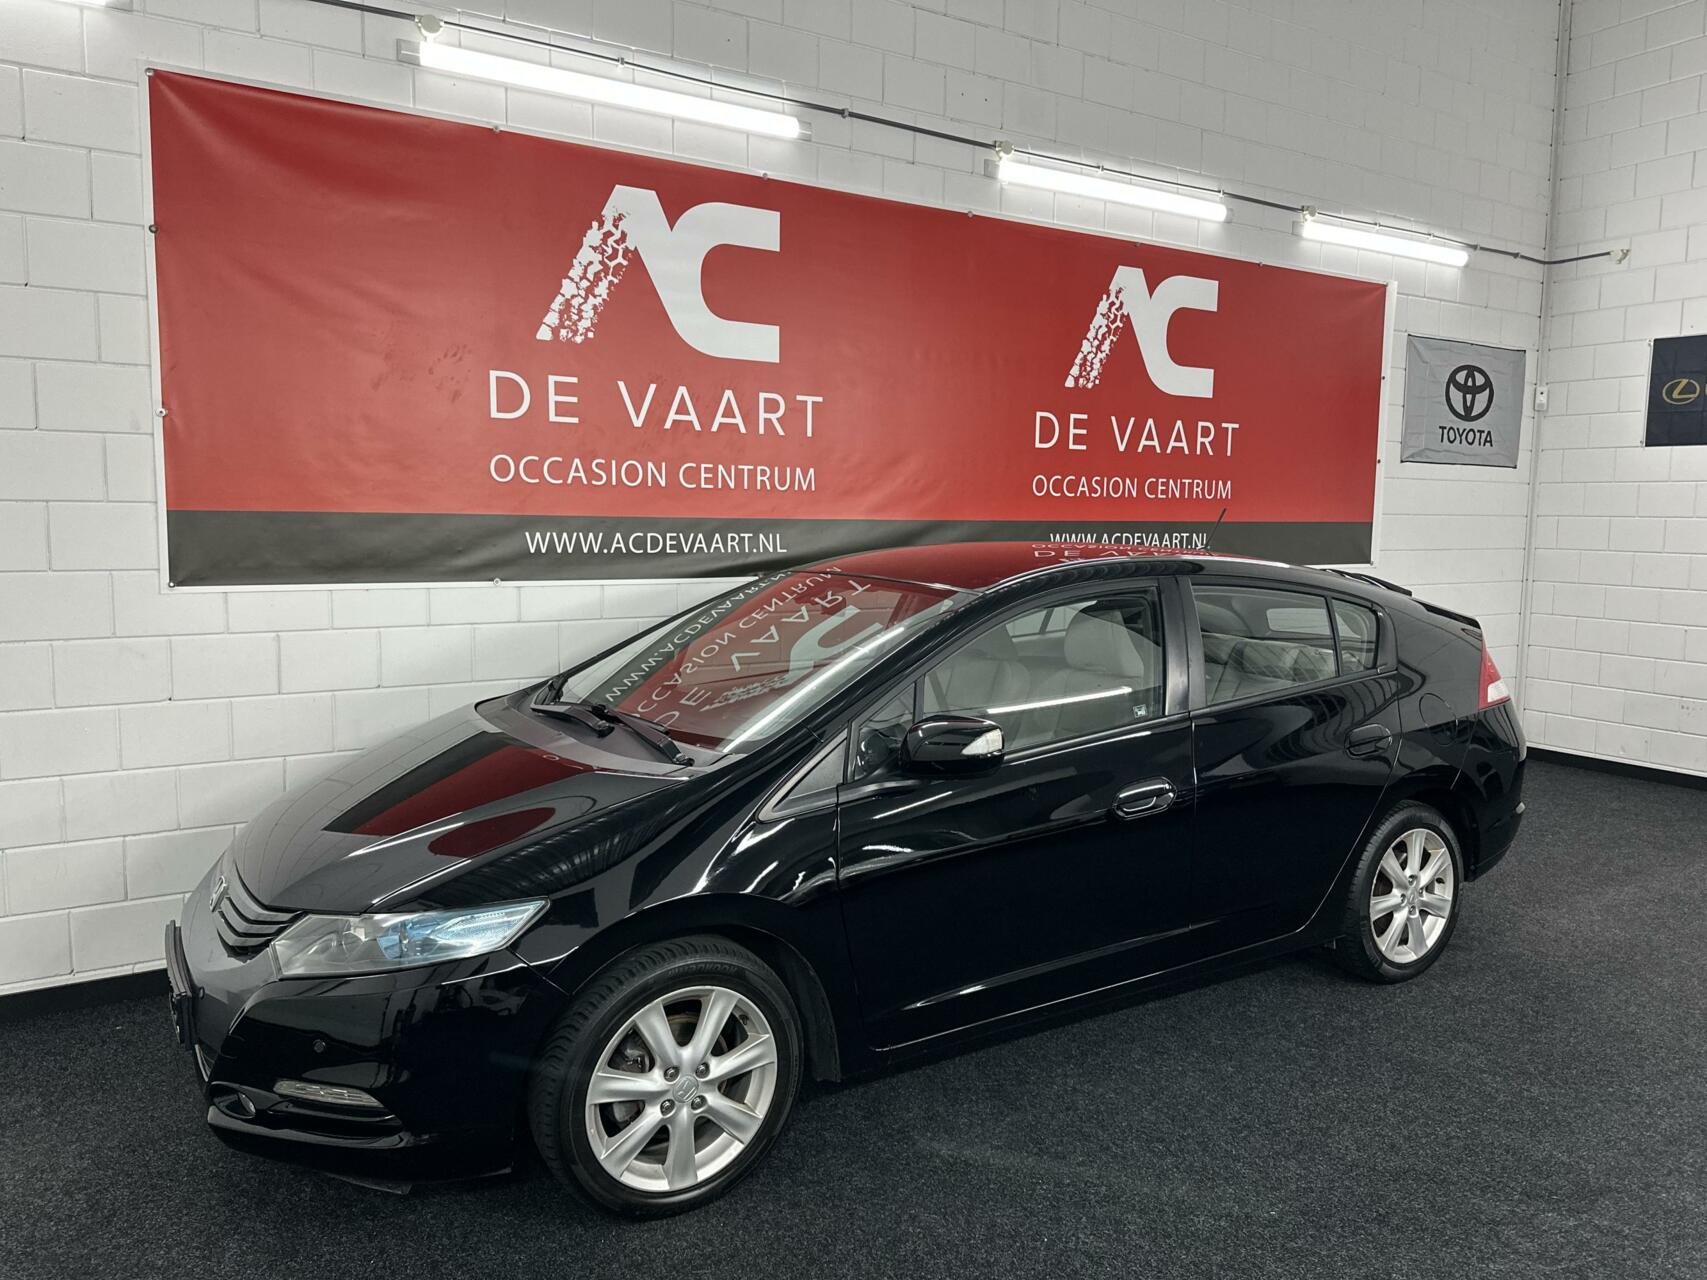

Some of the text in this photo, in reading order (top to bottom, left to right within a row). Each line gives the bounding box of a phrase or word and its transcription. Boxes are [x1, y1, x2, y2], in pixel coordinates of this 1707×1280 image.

[536, 184, 781, 364] AC
[1064, 265, 1219, 399] AC
[489, 370, 823, 437] DE VAART
[1034, 411, 1239, 456] DE VAART
[1438, 425, 1493, 447] TOYOTA
[490, 455, 816, 491] OCCASION CENTRUM
[1032, 475, 1231, 499] OCCASION CENTRUM
[525, 532, 787, 554] WWW.ACDEVAART.NL
